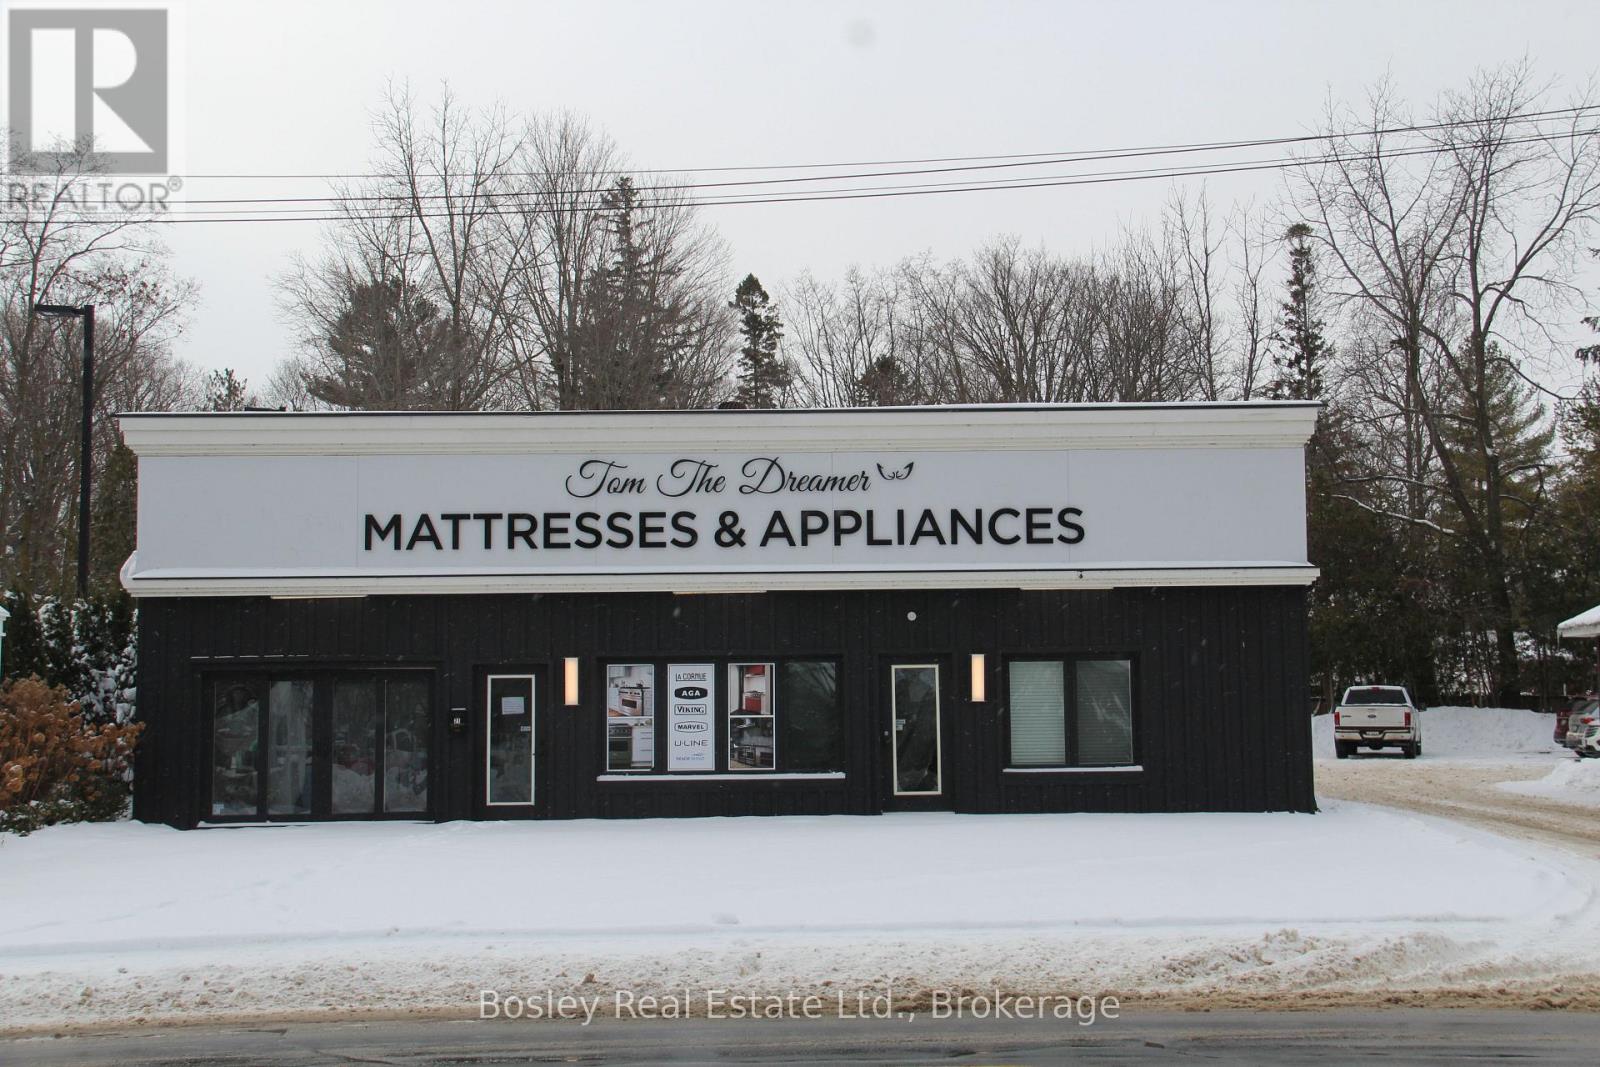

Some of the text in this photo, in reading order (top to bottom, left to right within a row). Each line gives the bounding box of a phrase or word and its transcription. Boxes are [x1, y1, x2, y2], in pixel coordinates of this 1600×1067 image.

[565, 457, 871, 498] Tom The Dreamer
[364, 507, 1085, 551] MATTRESSES & APPLIANCES
